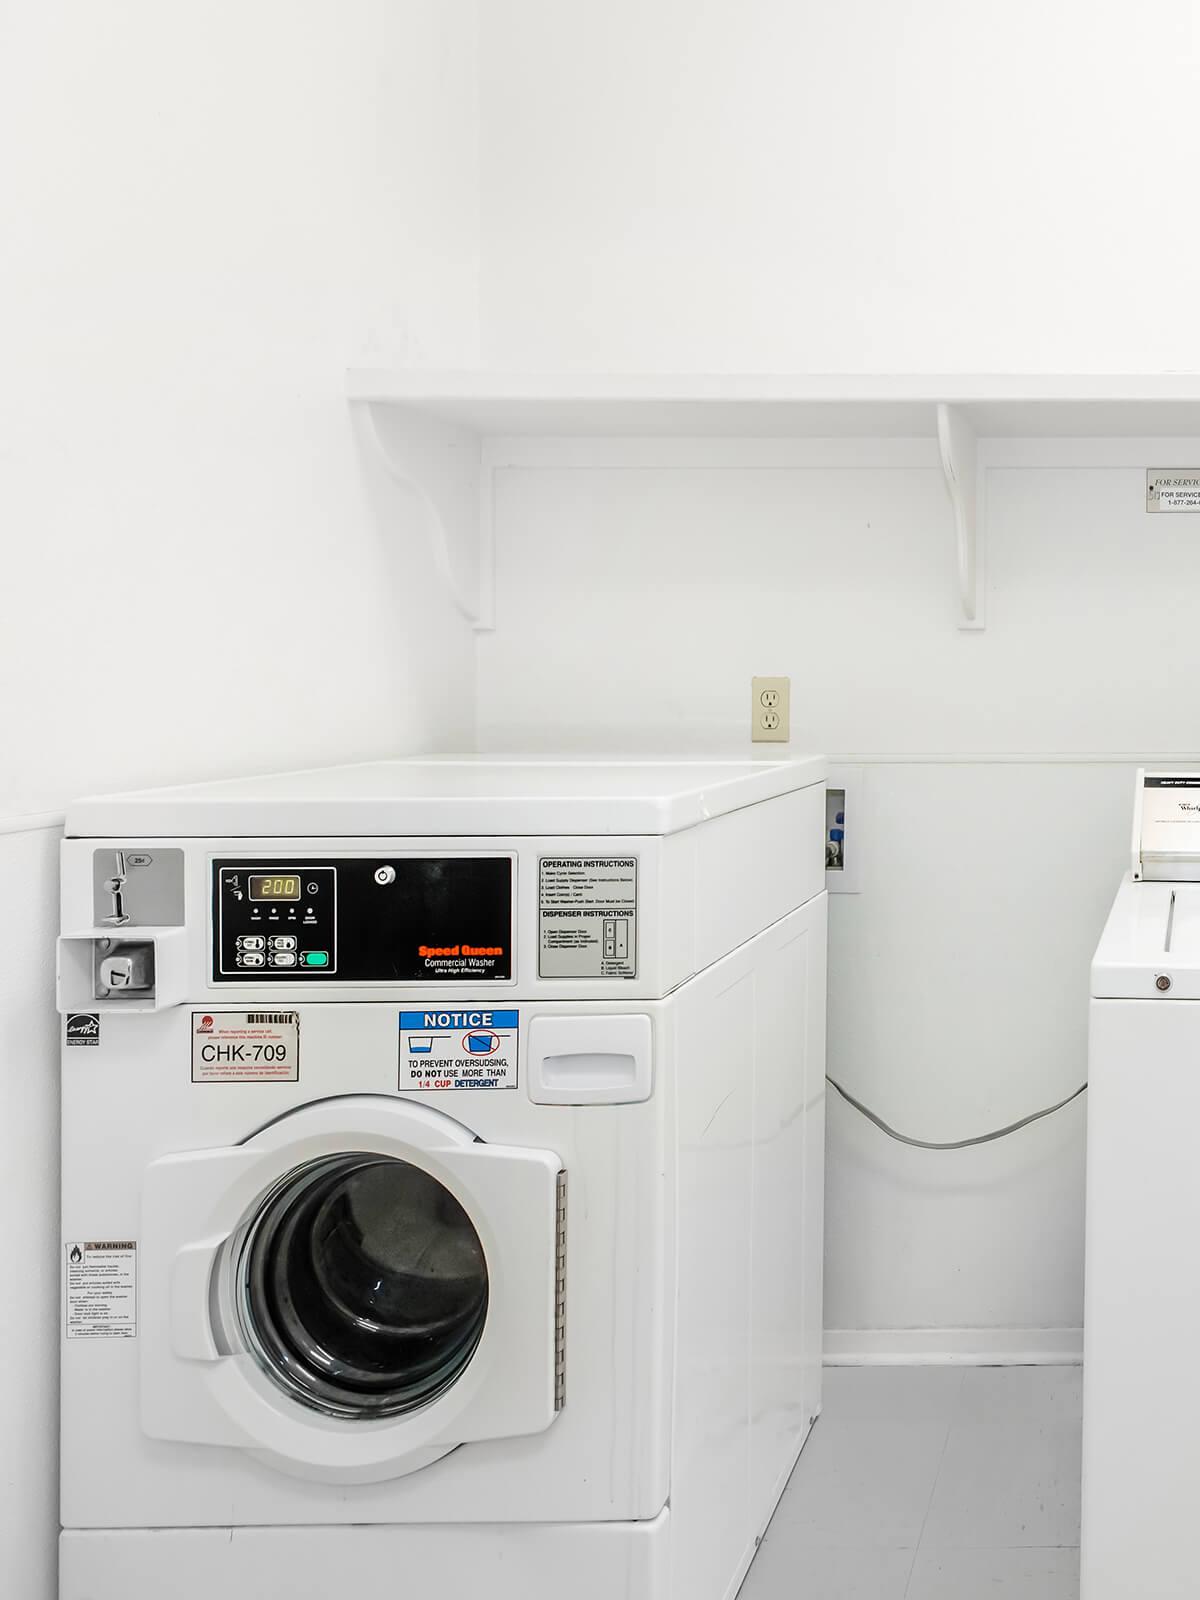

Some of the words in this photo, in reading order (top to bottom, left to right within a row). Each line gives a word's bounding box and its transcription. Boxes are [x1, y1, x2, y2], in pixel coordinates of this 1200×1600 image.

[262, 880, 294, 894] 200
[418, 945, 459, 958] Speed
[461, 945, 503, 955] Queen
[425, 958, 466, 967] Commercial
[468, 958, 495, 966] Washer
[424, 1014, 493, 1027] NOTICE
[202, 1045, 286, 1062] CHK-709
[455, 1059, 508, 1067] OVERSUDSING,
[455, 1079, 499, 1087] DETERGENT
